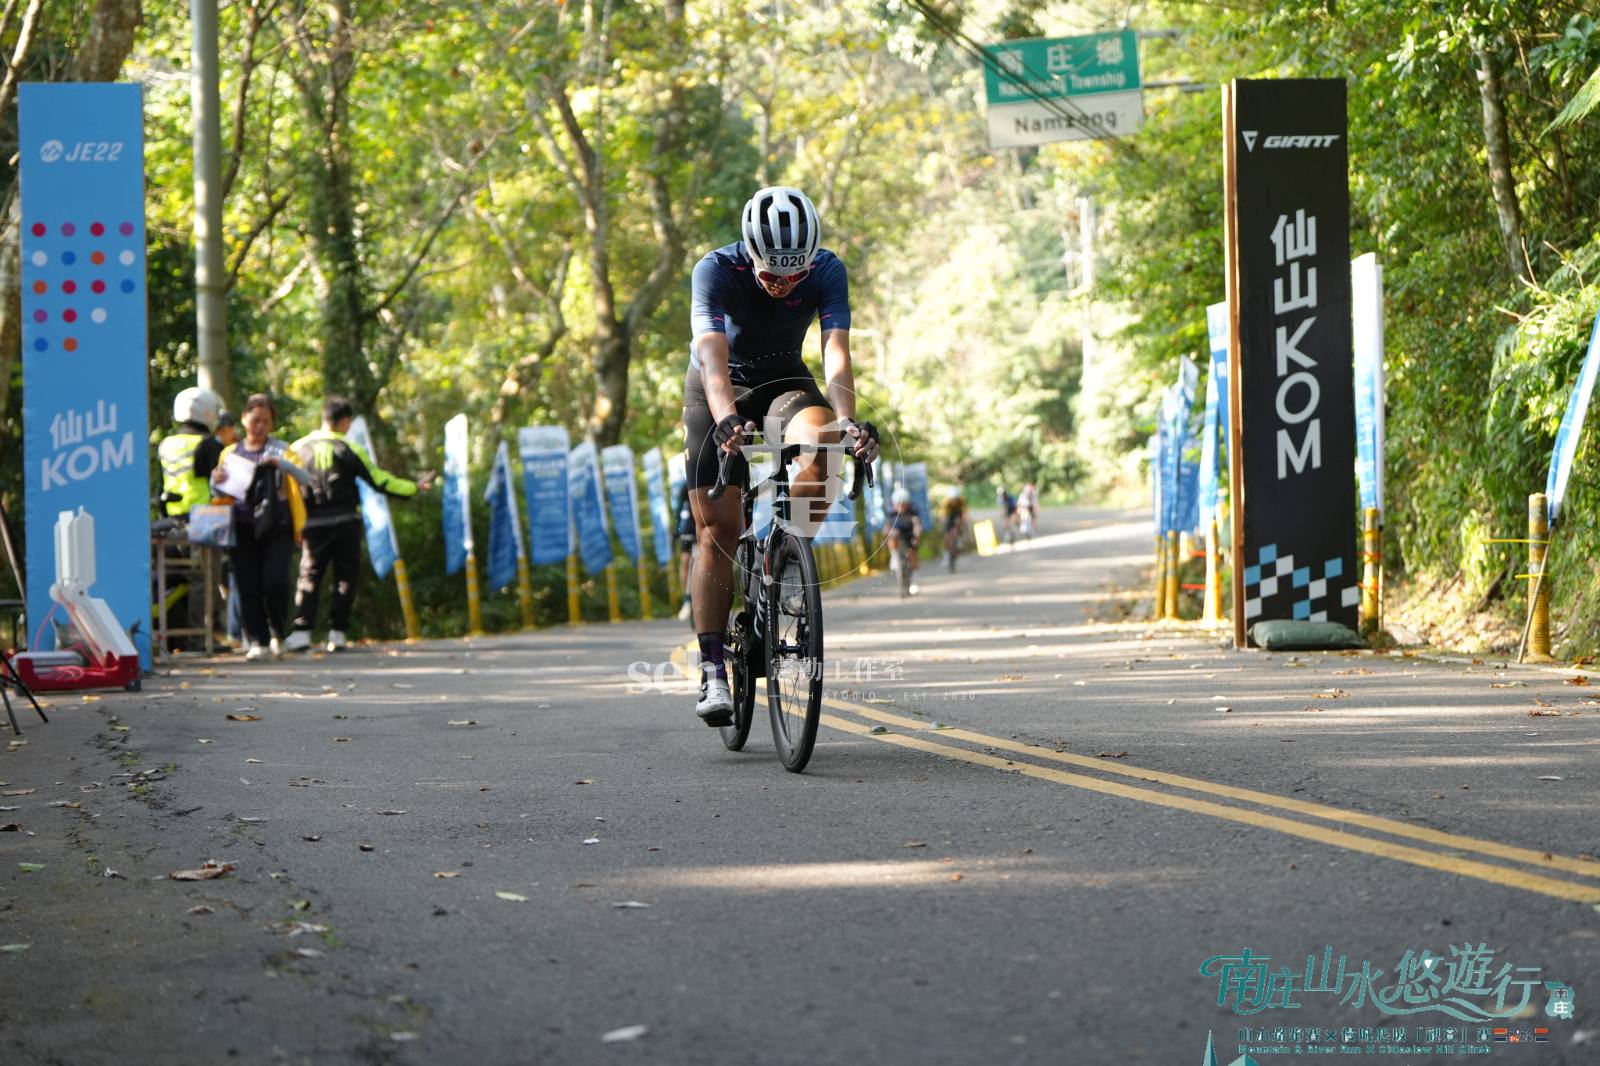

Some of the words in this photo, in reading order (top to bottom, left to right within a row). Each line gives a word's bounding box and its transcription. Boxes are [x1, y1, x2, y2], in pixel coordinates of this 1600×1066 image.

[1071, 71, 1126, 89] Township
[1263, 134, 1340, 149] GIANT
[65, 142, 124, 161] JE22
[49, 399, 117, 451] 仙山
[41, 431, 134, 492] KOM
